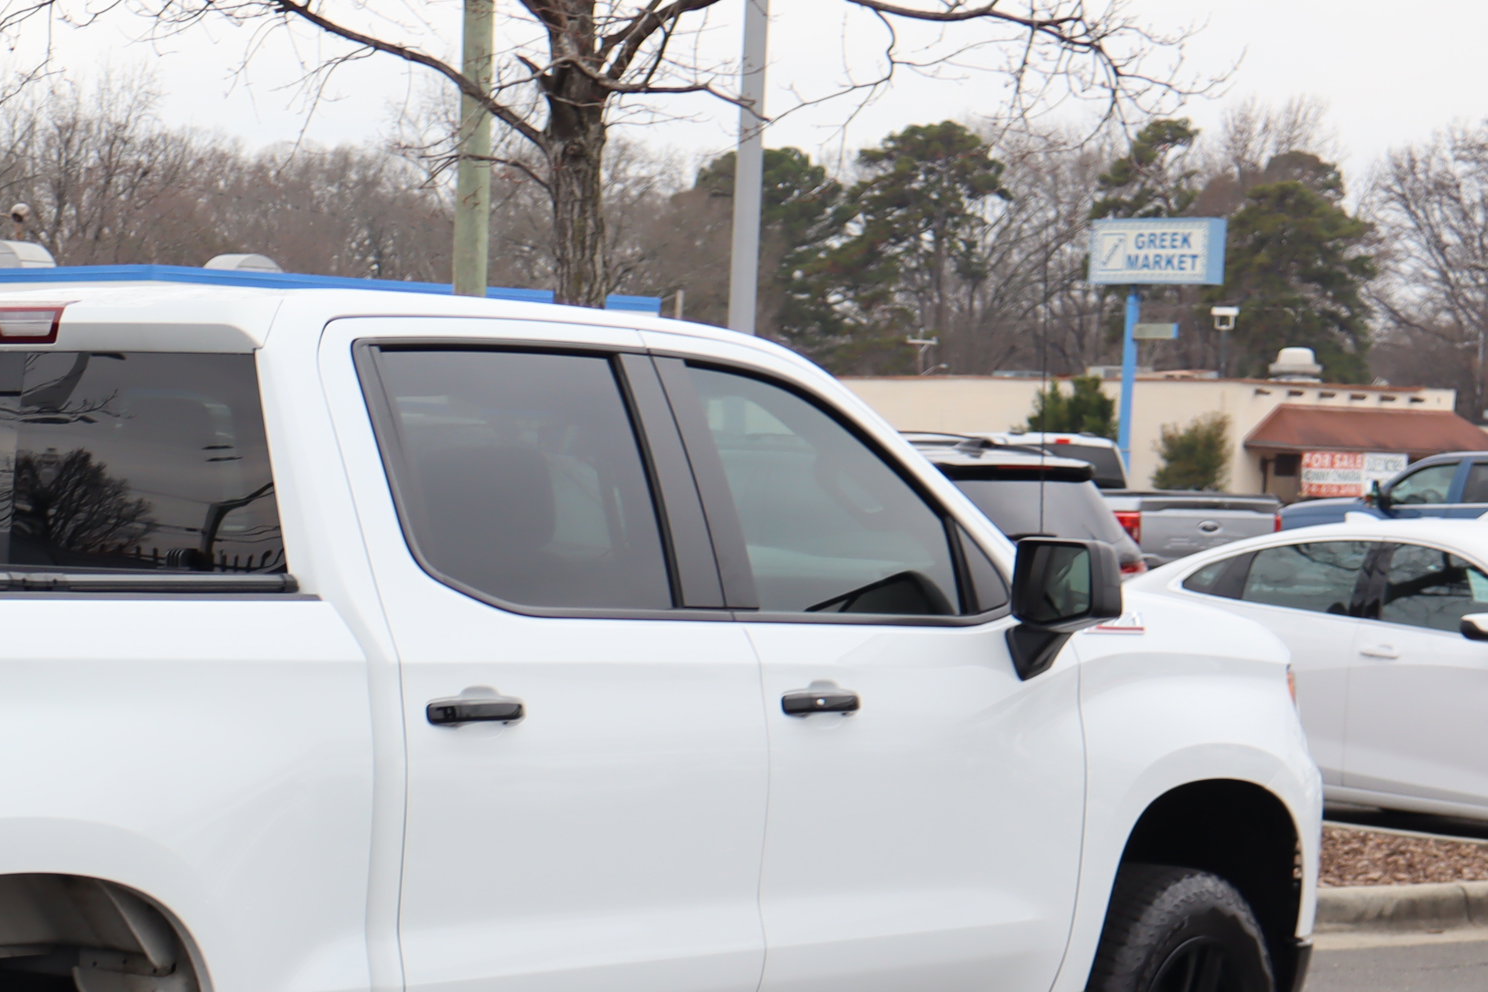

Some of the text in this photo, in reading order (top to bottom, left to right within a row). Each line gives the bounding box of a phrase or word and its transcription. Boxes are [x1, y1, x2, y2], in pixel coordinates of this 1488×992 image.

[1134, 232, 1192, 250] GREEK
[1126, 254, 1199, 271] MARKET
[1302, 453, 1331, 468] FOR
[1332, 453, 1363, 469] SALE
